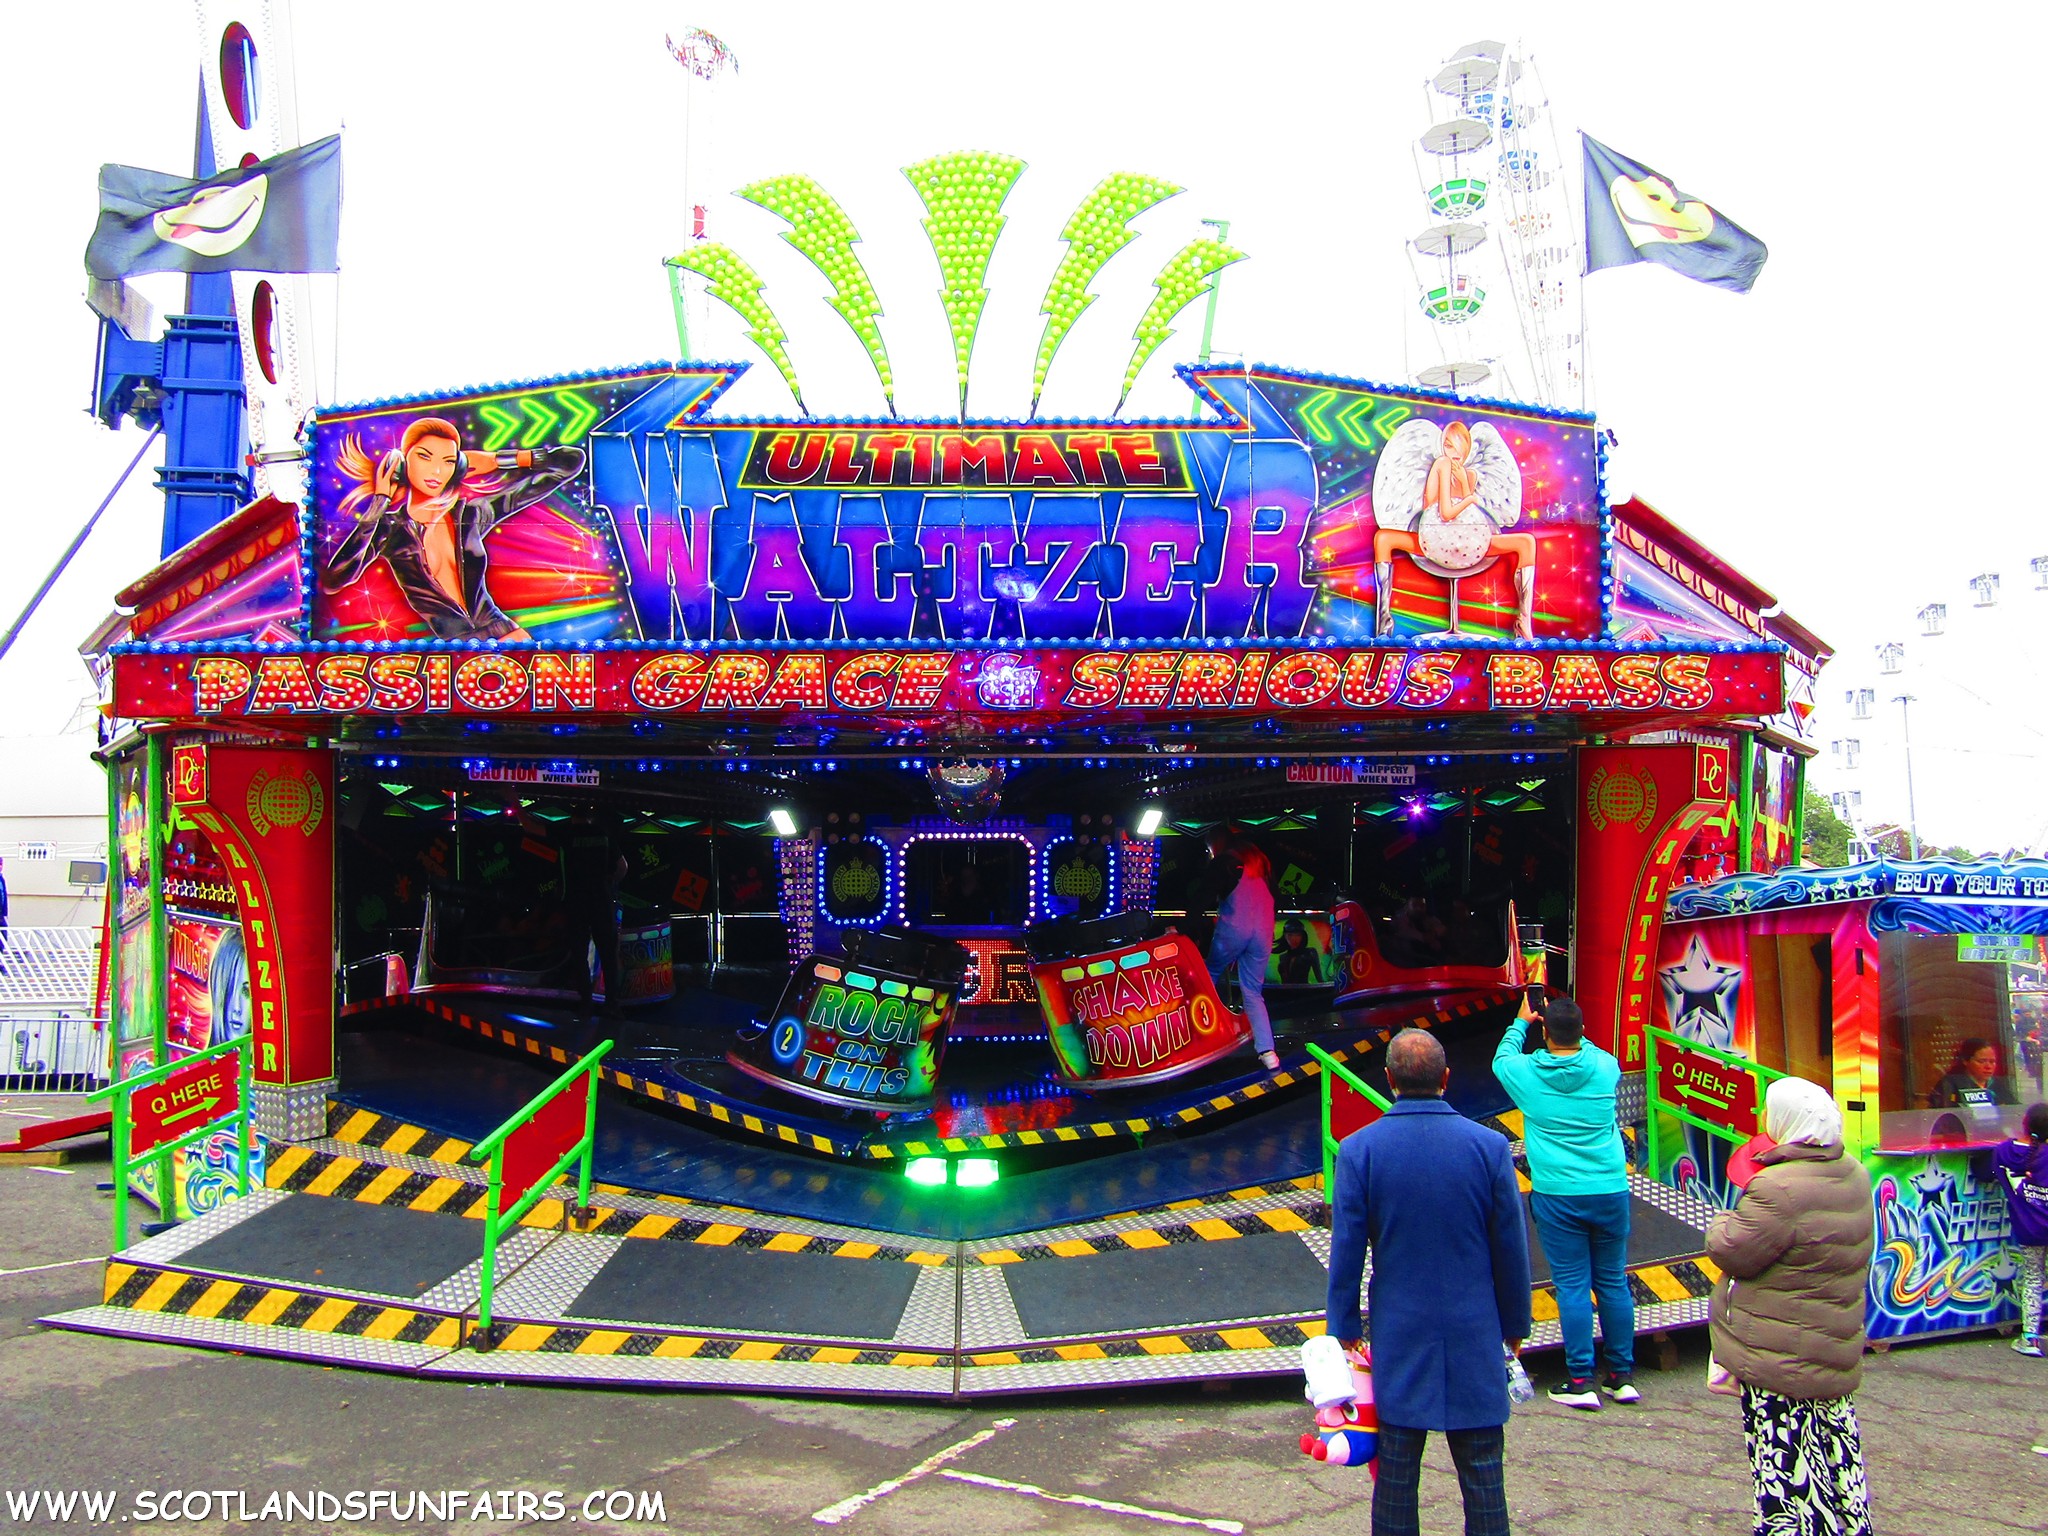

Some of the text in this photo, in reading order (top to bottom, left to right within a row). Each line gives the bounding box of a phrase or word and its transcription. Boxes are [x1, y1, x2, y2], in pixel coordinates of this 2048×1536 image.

[765, 433, 1169, 487] ULTIMATE
[588, 433, 1319, 640] WALTZER
[193, 650, 1715, 712] PASSION GRACE & SERIOUS BASS
[542, 774, 599, 784] WHEN WET
[1287, 764, 1353, 782] CAUTION
[1357, 775, 1414, 785] WHEN WET
[1362, 765, 1409, 775] SLIPPERY
[1702, 753, 1723, 794] DC
[247, 768, 271, 836] MINISTRY
[303, 771, 323, 836] OF SOUND
[1587, 768, 1607, 831] MINISTRY
[1637, 785, 1657, 832] SOUND
[1895, 872, 1948, 894] BUY
[1953, 874, 2017, 896] YOUR
[173, 928, 210, 982] MUSIC
[191, 811, 277, 1072] WALTZER
[808, 984, 930, 1046] ROCK
[1073, 966, 1184, 1022] SHAKE
[1199, 1001, 1210, 1026] 3
[780, 1026, 794, 1052] 2
[836, 1040, 887, 1063] ON
[1086, 1006, 1191, 1068] DOWN
[802, 1050, 909, 1095] THIS
[1672, 1062, 1686, 1079] Q
[150, 1073, 224, 1115] Q HERE
[1964, 1092, 1988, 1102] PRICE
